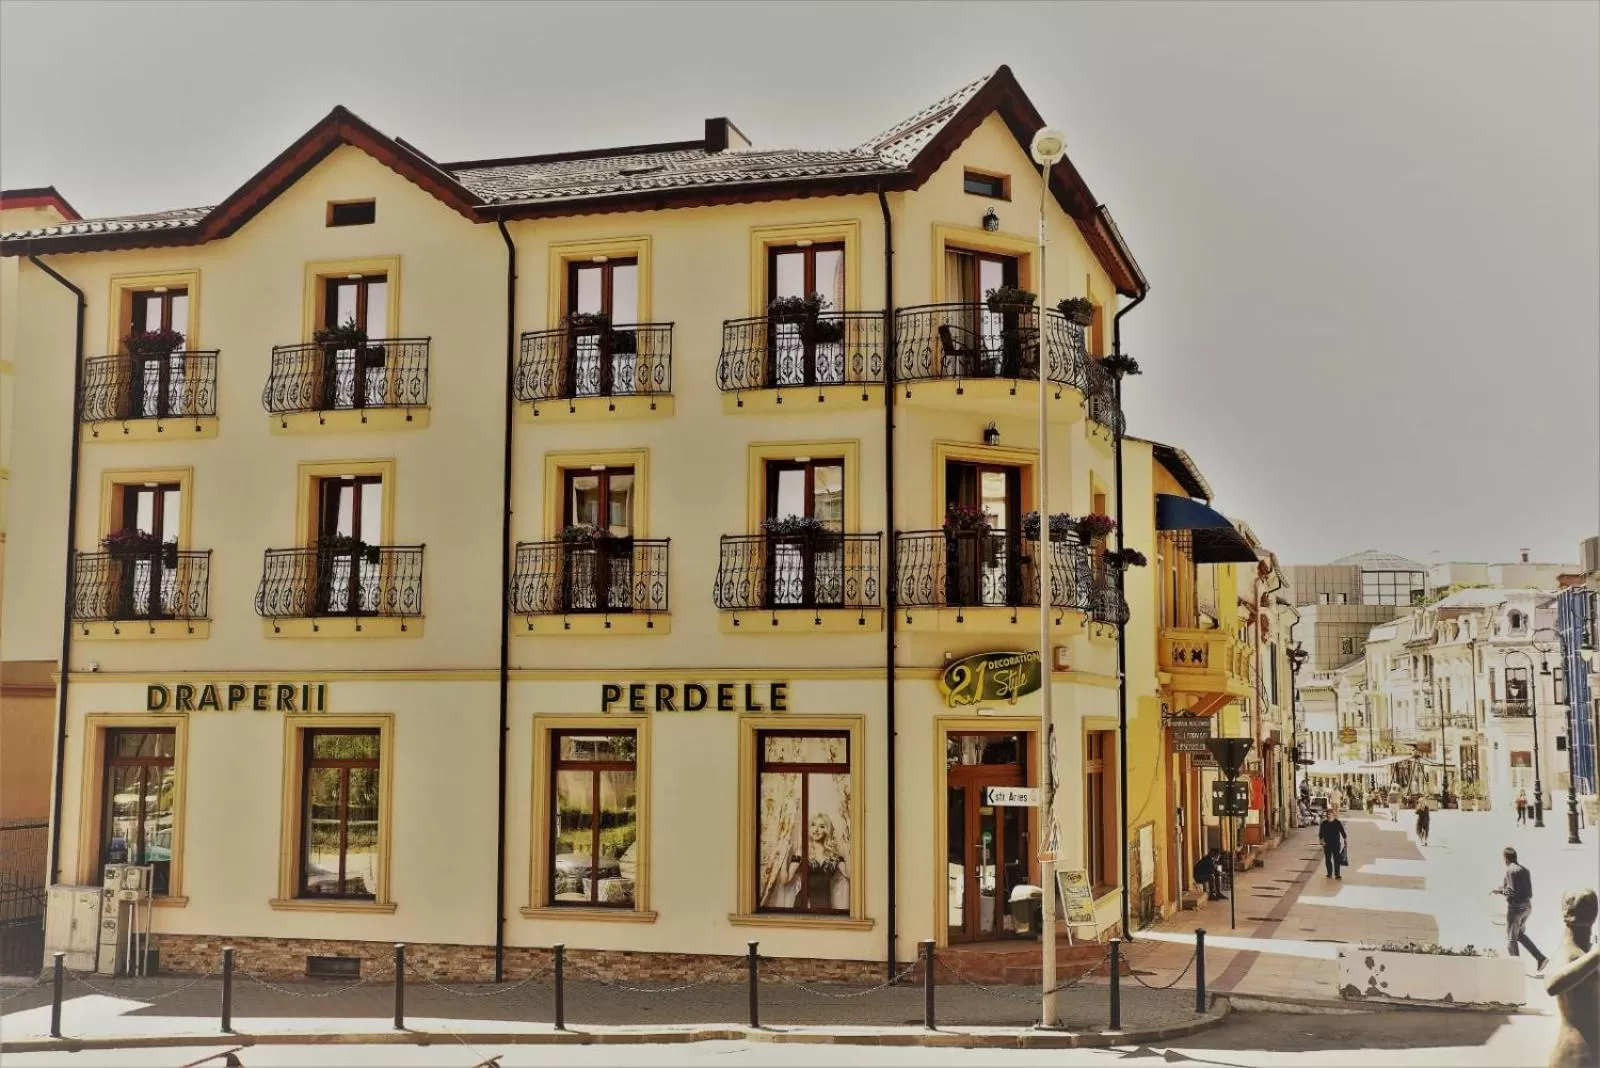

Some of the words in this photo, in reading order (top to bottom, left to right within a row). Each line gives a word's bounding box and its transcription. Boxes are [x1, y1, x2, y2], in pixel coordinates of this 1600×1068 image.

[949, 661, 987, 707] 21
[988, 652, 1040, 670] DECORATION
[993, 664, 1027, 705] Style
[147, 684, 326, 712] DRAPERII
[601, 683, 788, 713] PERDELE
